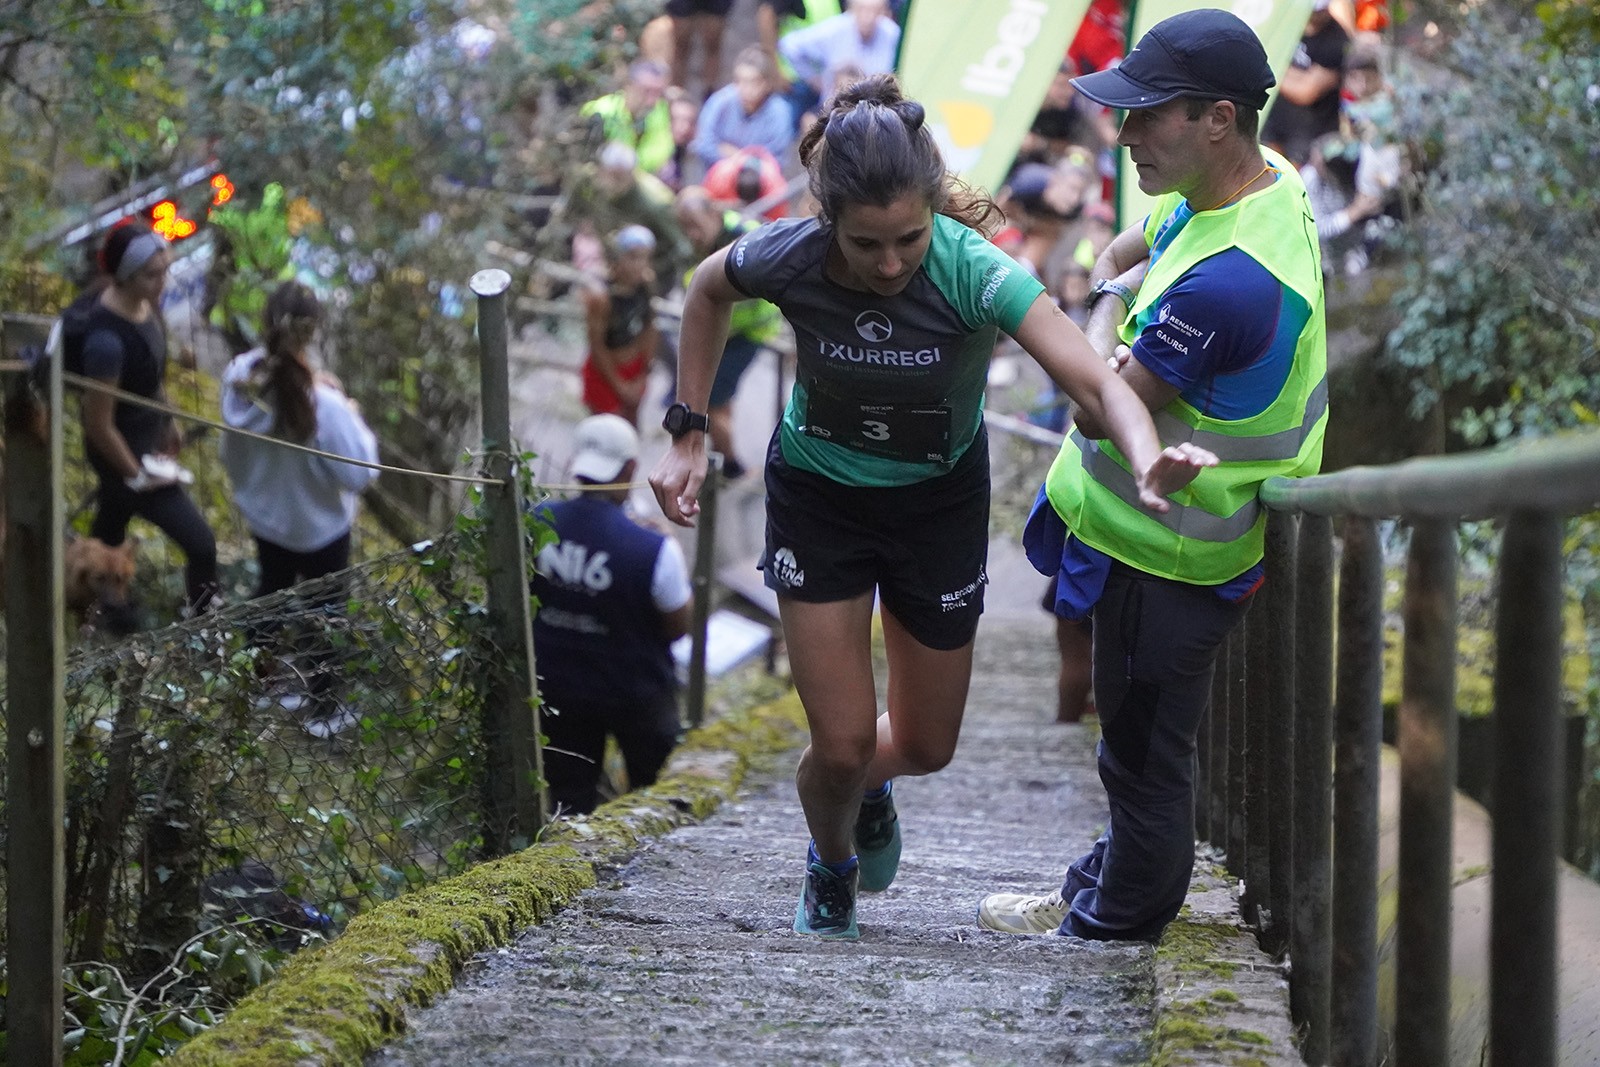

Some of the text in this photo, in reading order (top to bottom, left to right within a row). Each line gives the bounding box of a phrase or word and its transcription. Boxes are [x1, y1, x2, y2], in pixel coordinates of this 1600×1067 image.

[1169, 315, 1203, 337] RENAULT
[816, 338, 941, 366] TXURREGI
[1156, 329, 1189, 355] GAURSA
[861, 420, 891, 440] 3
